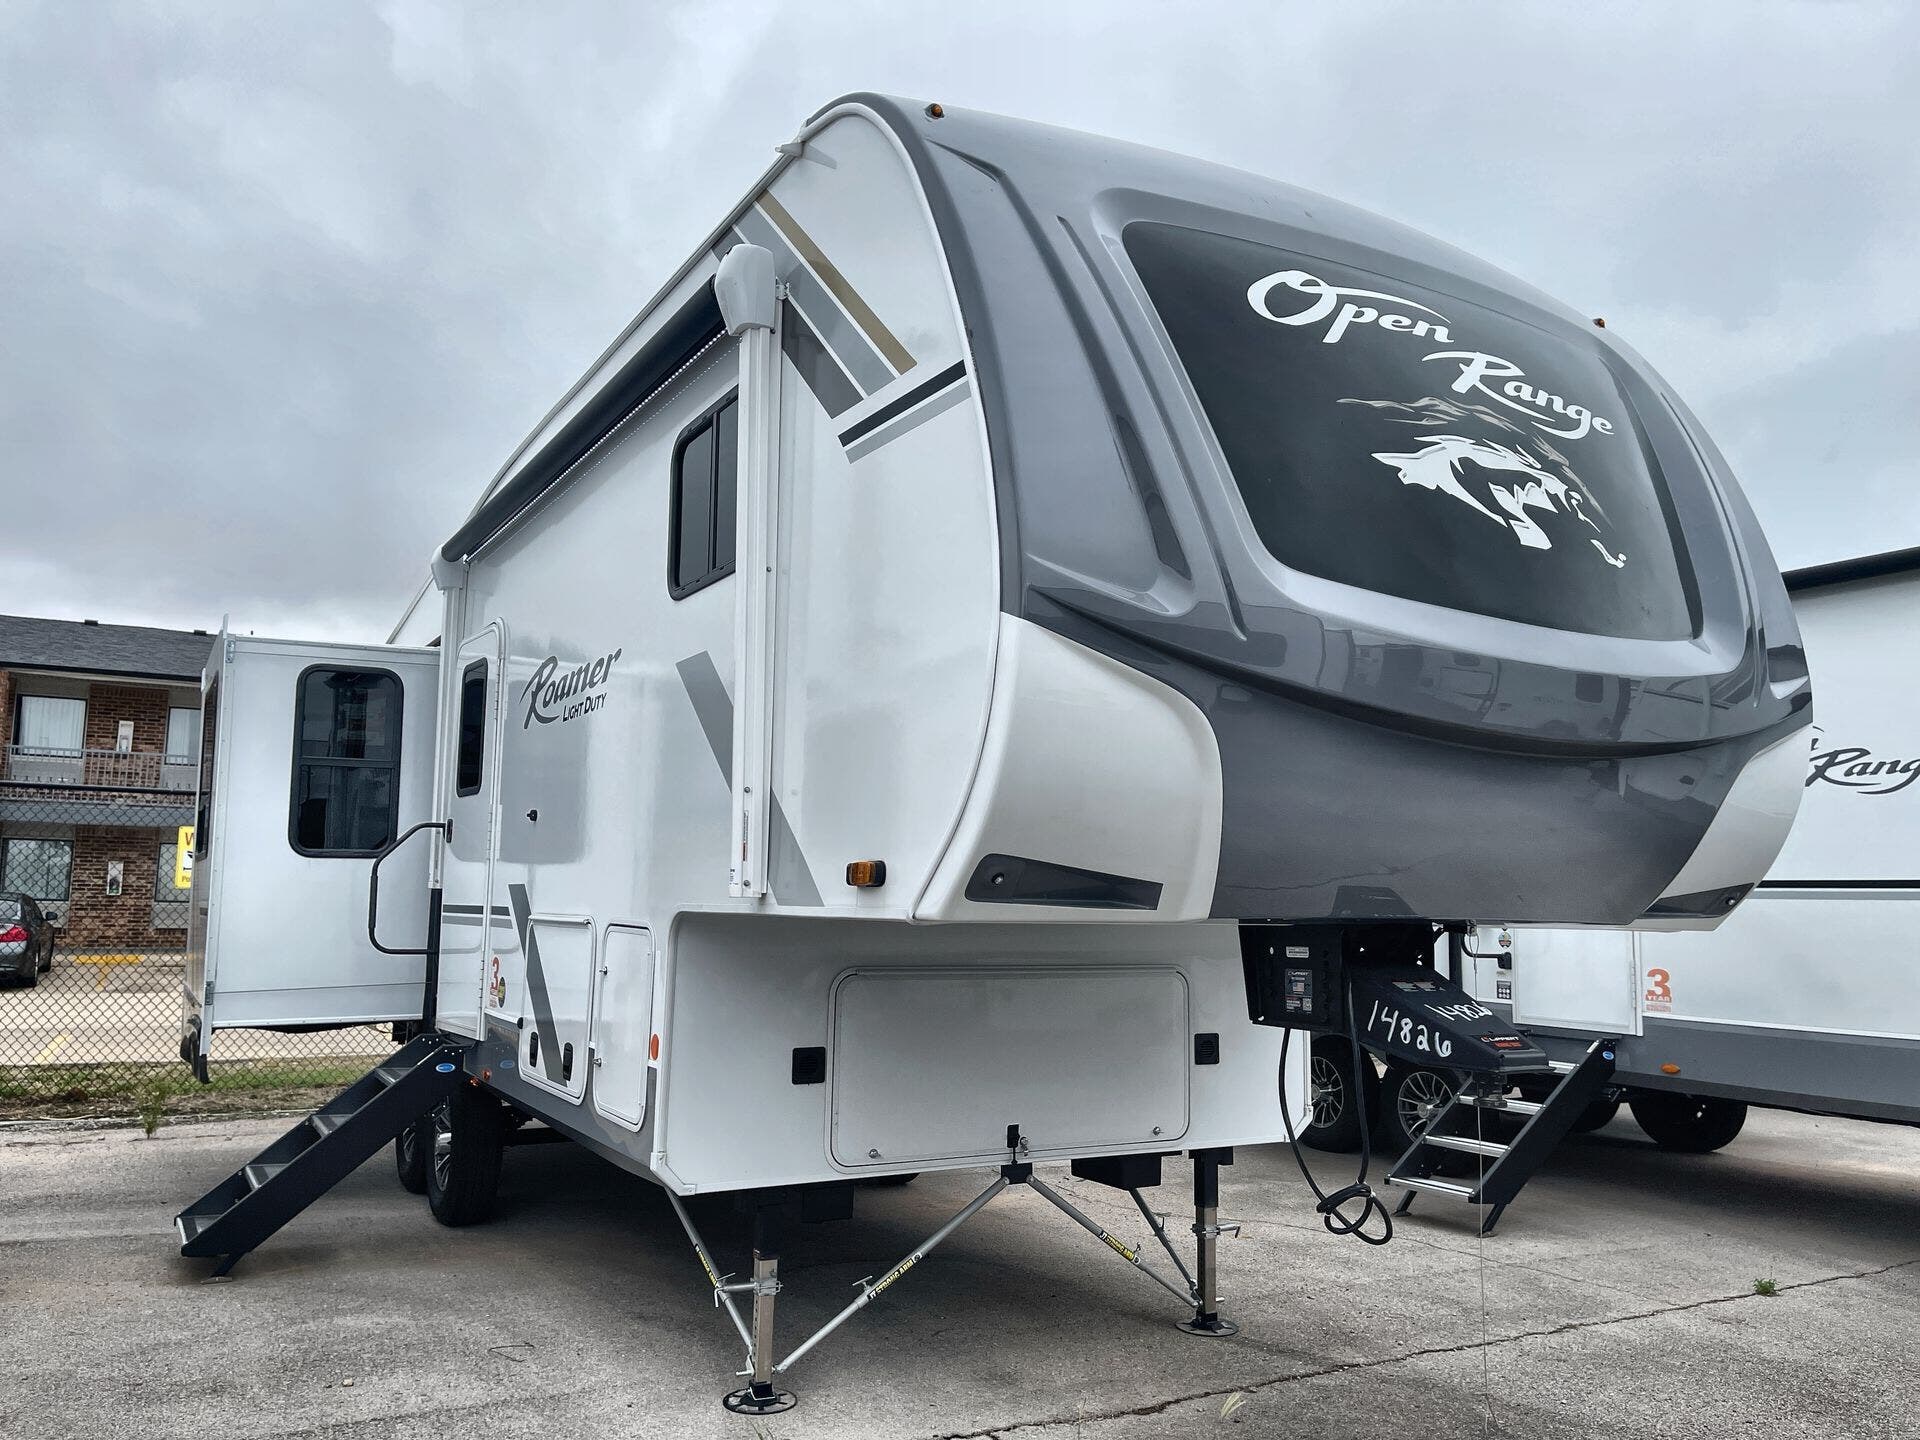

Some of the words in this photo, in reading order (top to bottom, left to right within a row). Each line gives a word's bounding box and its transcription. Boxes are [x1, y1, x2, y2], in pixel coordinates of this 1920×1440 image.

[1247, 270, 1454, 343] Open
[1422, 351, 1615, 439] Range
[519, 648, 622, 729] Roamer
[584, 693, 607, 714] DUTY
[490, 956, 500, 991] 3
[1647, 968, 1671, 997] 3
[1367, 1000, 1453, 1058] 14826
